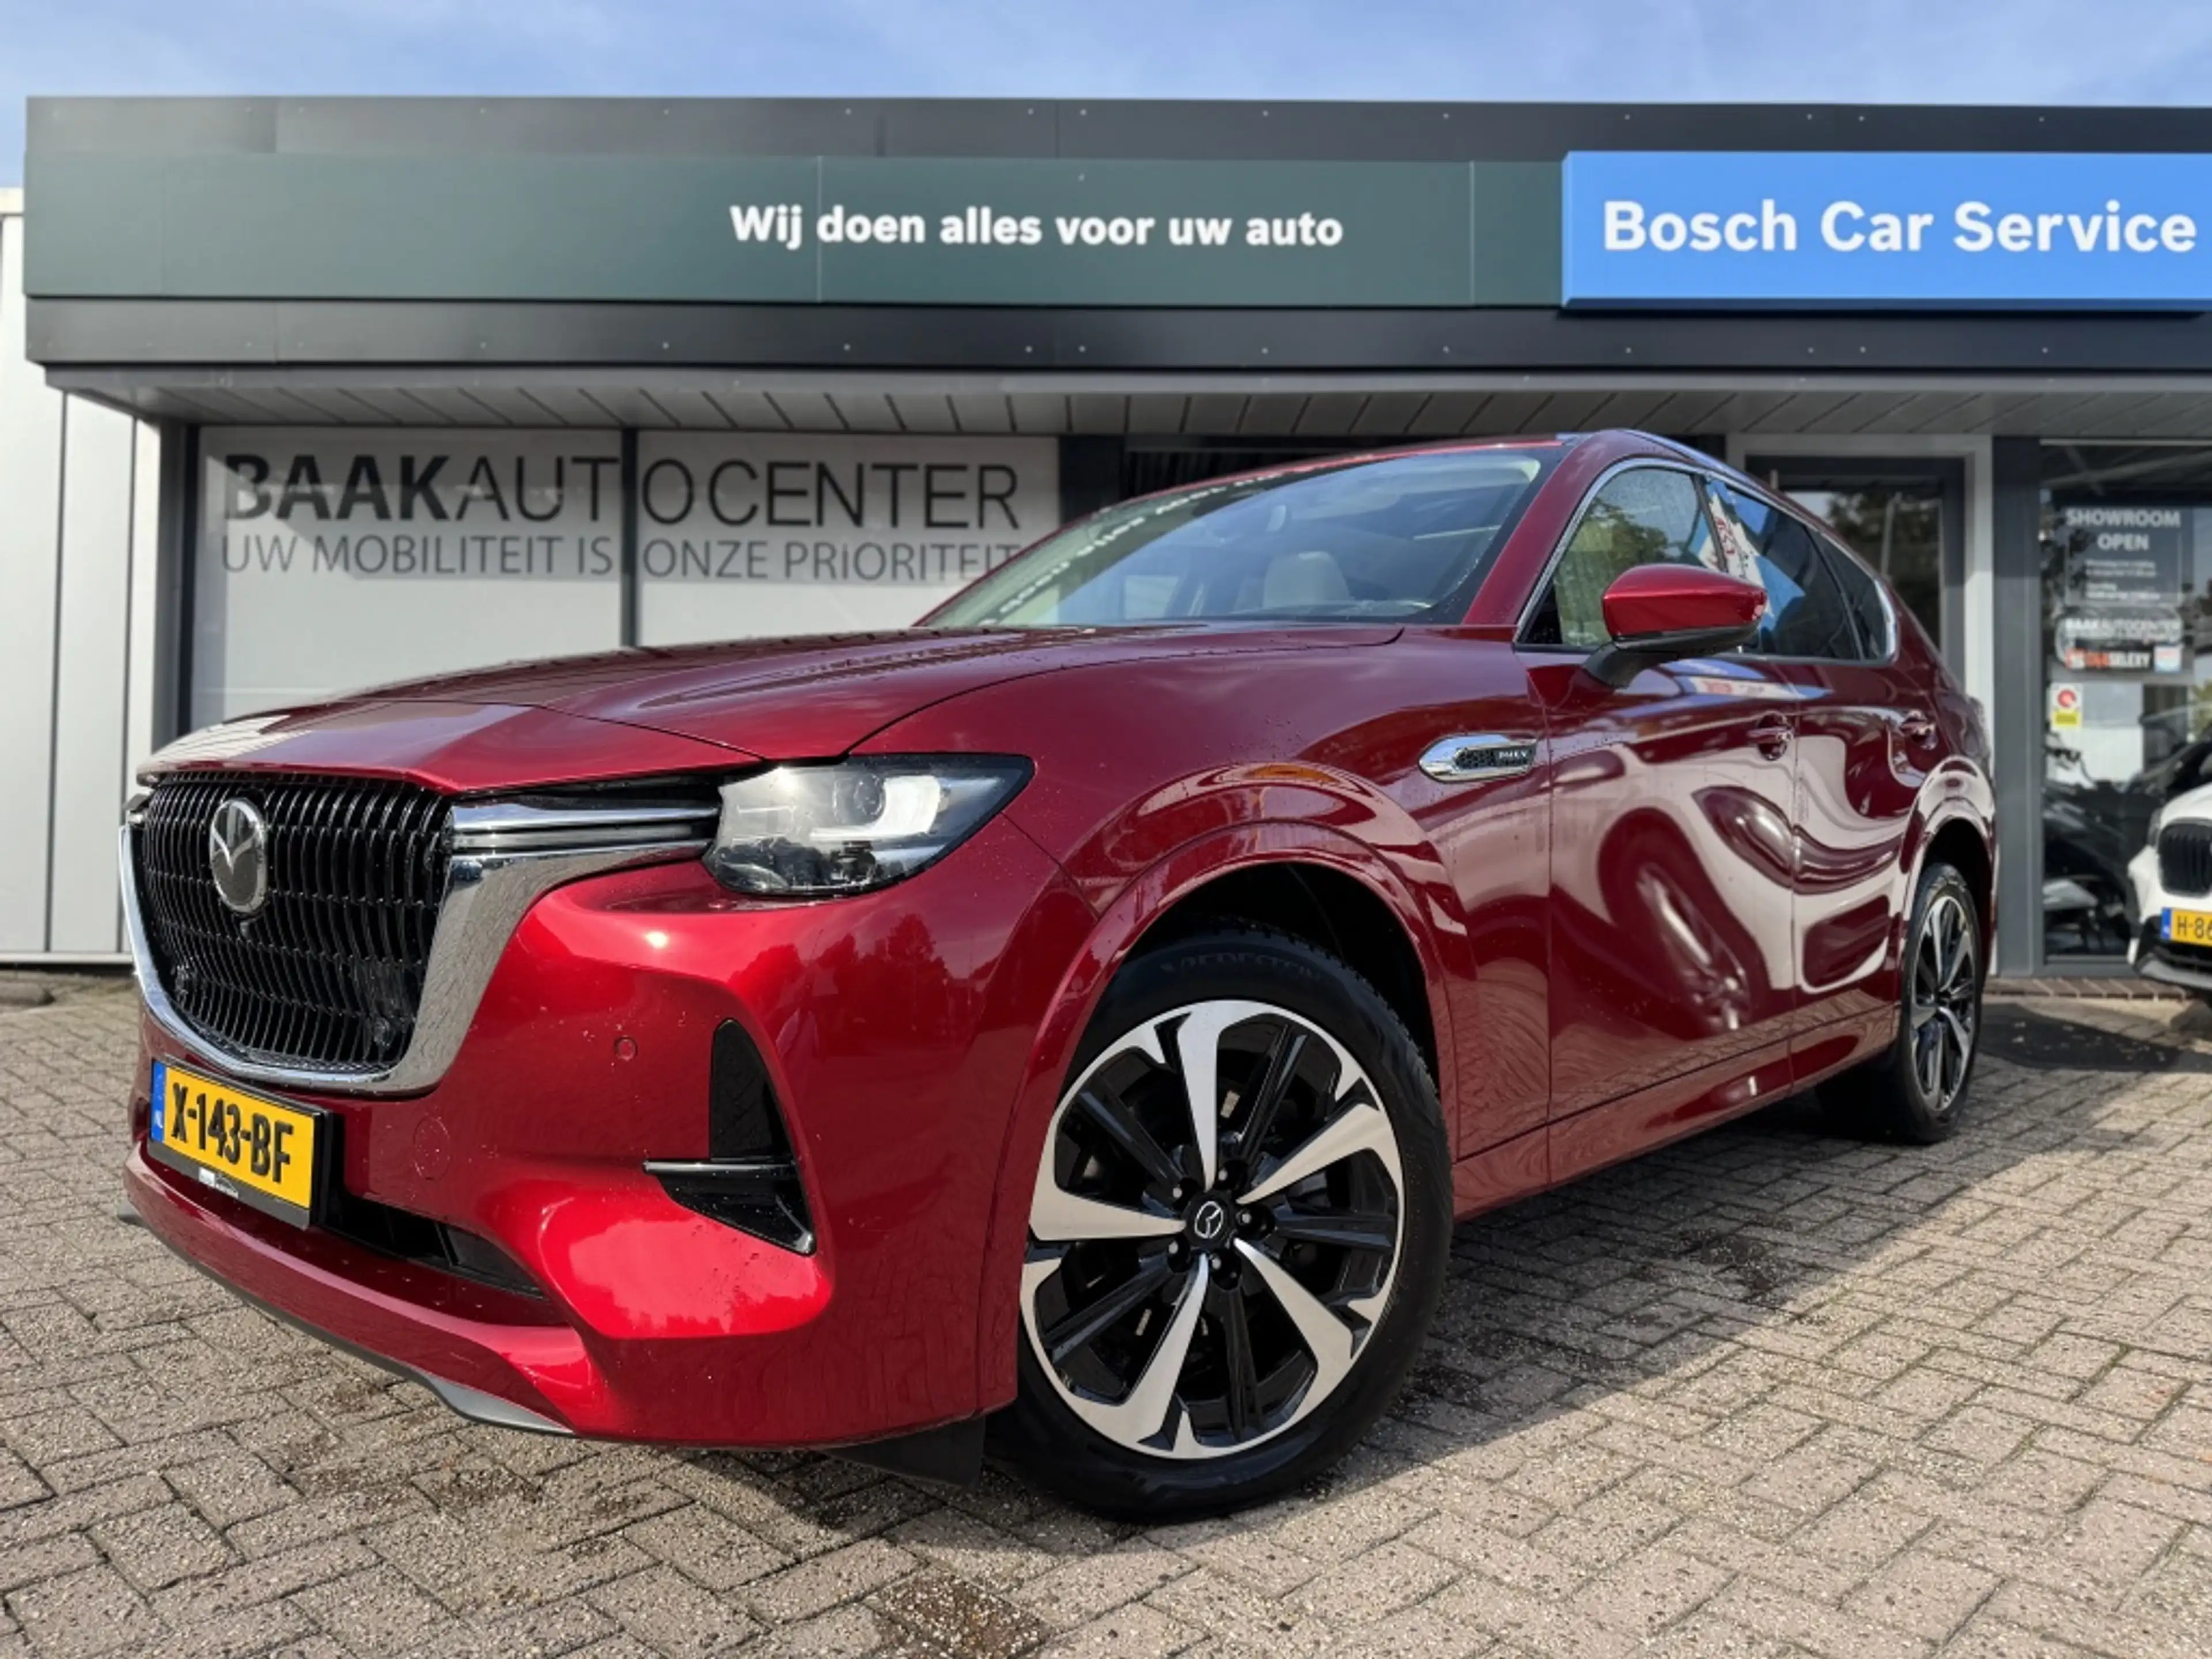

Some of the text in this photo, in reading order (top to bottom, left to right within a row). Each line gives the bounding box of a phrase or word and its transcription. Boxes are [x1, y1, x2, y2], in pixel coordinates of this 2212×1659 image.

[730, 204, 1343, 249] Wij doen alles voor uw auto
[1604, 199, 2196, 252] Bosch Car Service
[2066, 509, 2181, 528] SHOWROOM
[221, 535, 296, 573] UW
[312, 535, 563, 575] MOBILITEIT
[578, 536, 613, 575] IS
[642, 537, 768, 578] ONZE
[2097, 533, 2149, 551] OPEN
[171, 1082, 294, 1184] X-143-BF
